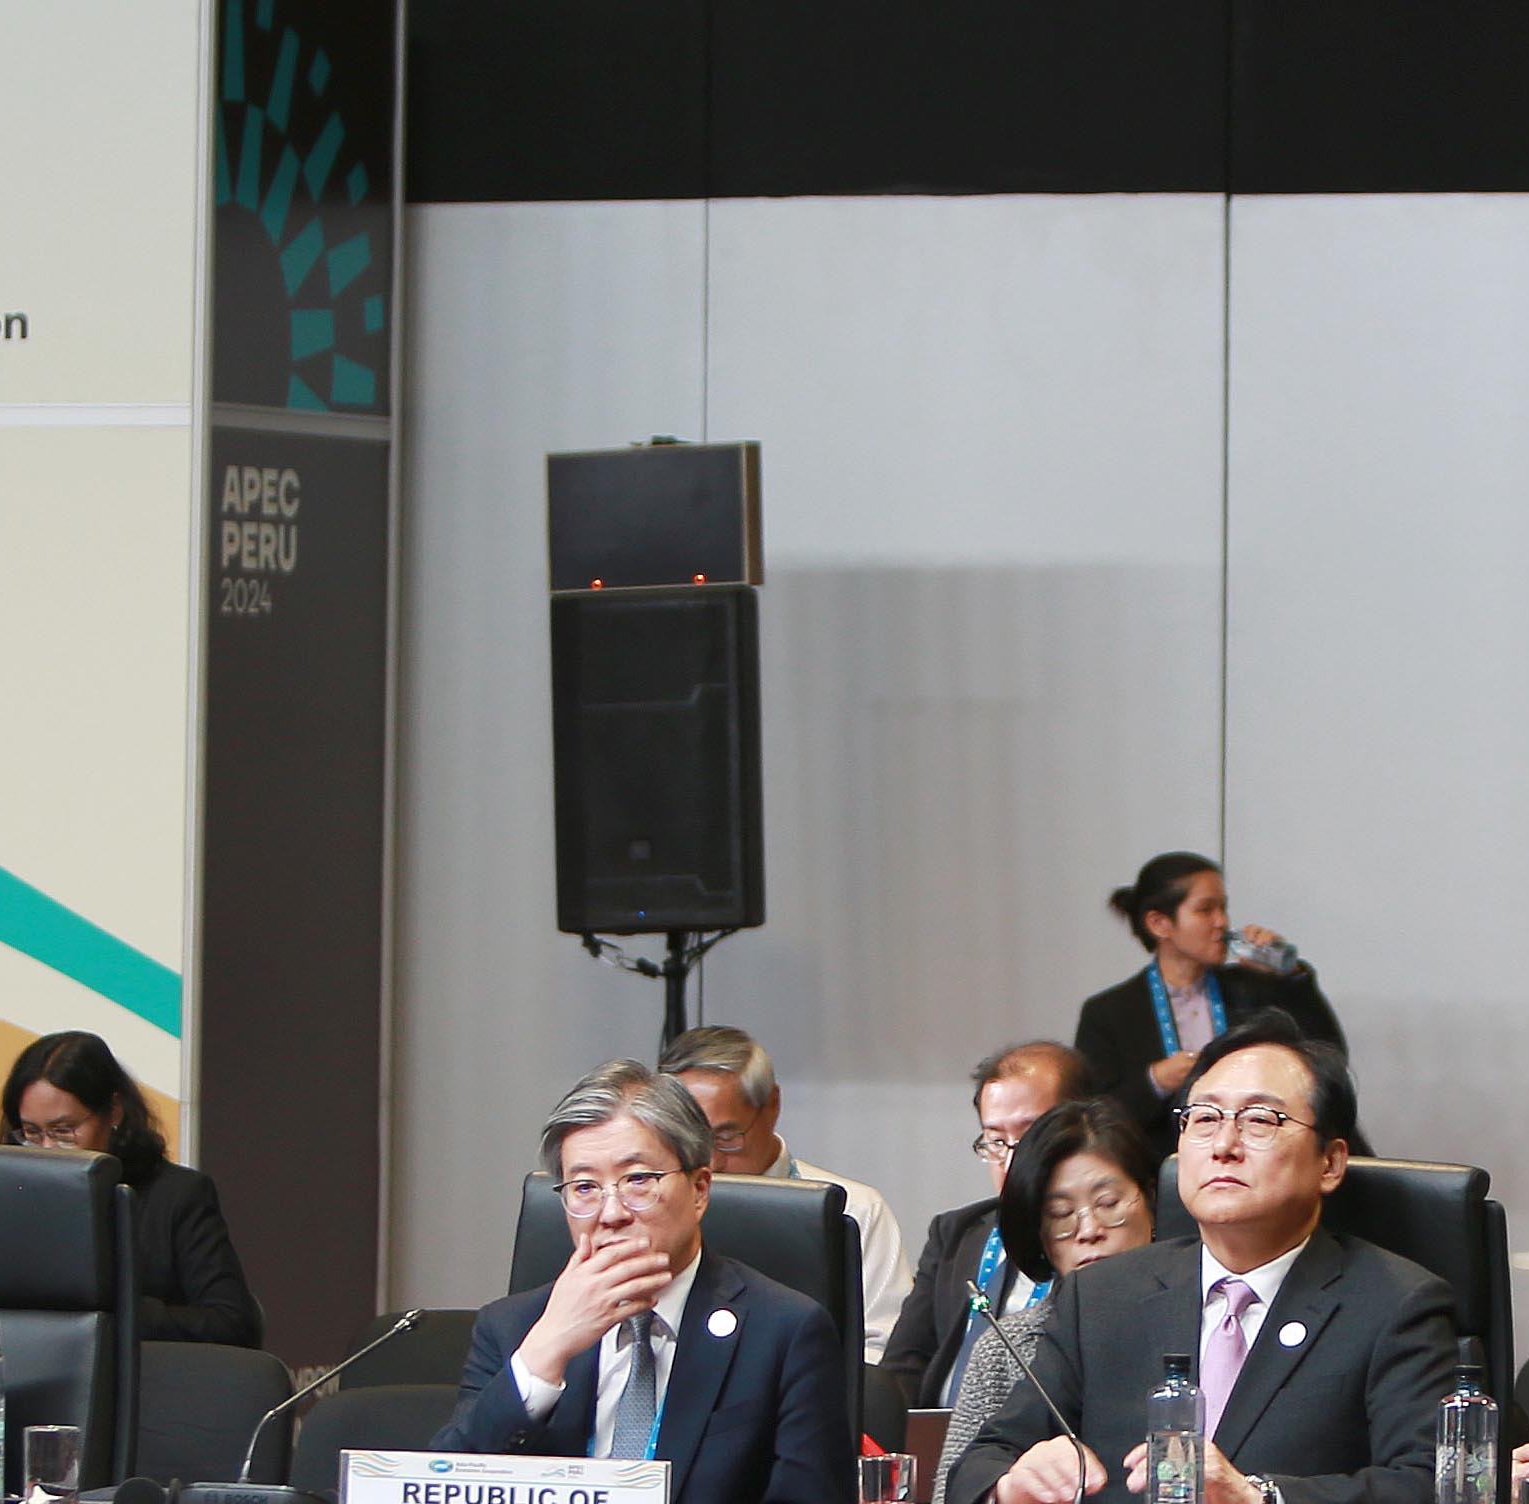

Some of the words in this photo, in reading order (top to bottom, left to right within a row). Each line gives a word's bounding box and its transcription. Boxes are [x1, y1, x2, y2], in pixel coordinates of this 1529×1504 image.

[222, 464, 301, 518] APEC
[222, 520, 298, 572] PERU
[221, 577, 273, 613] 2024
